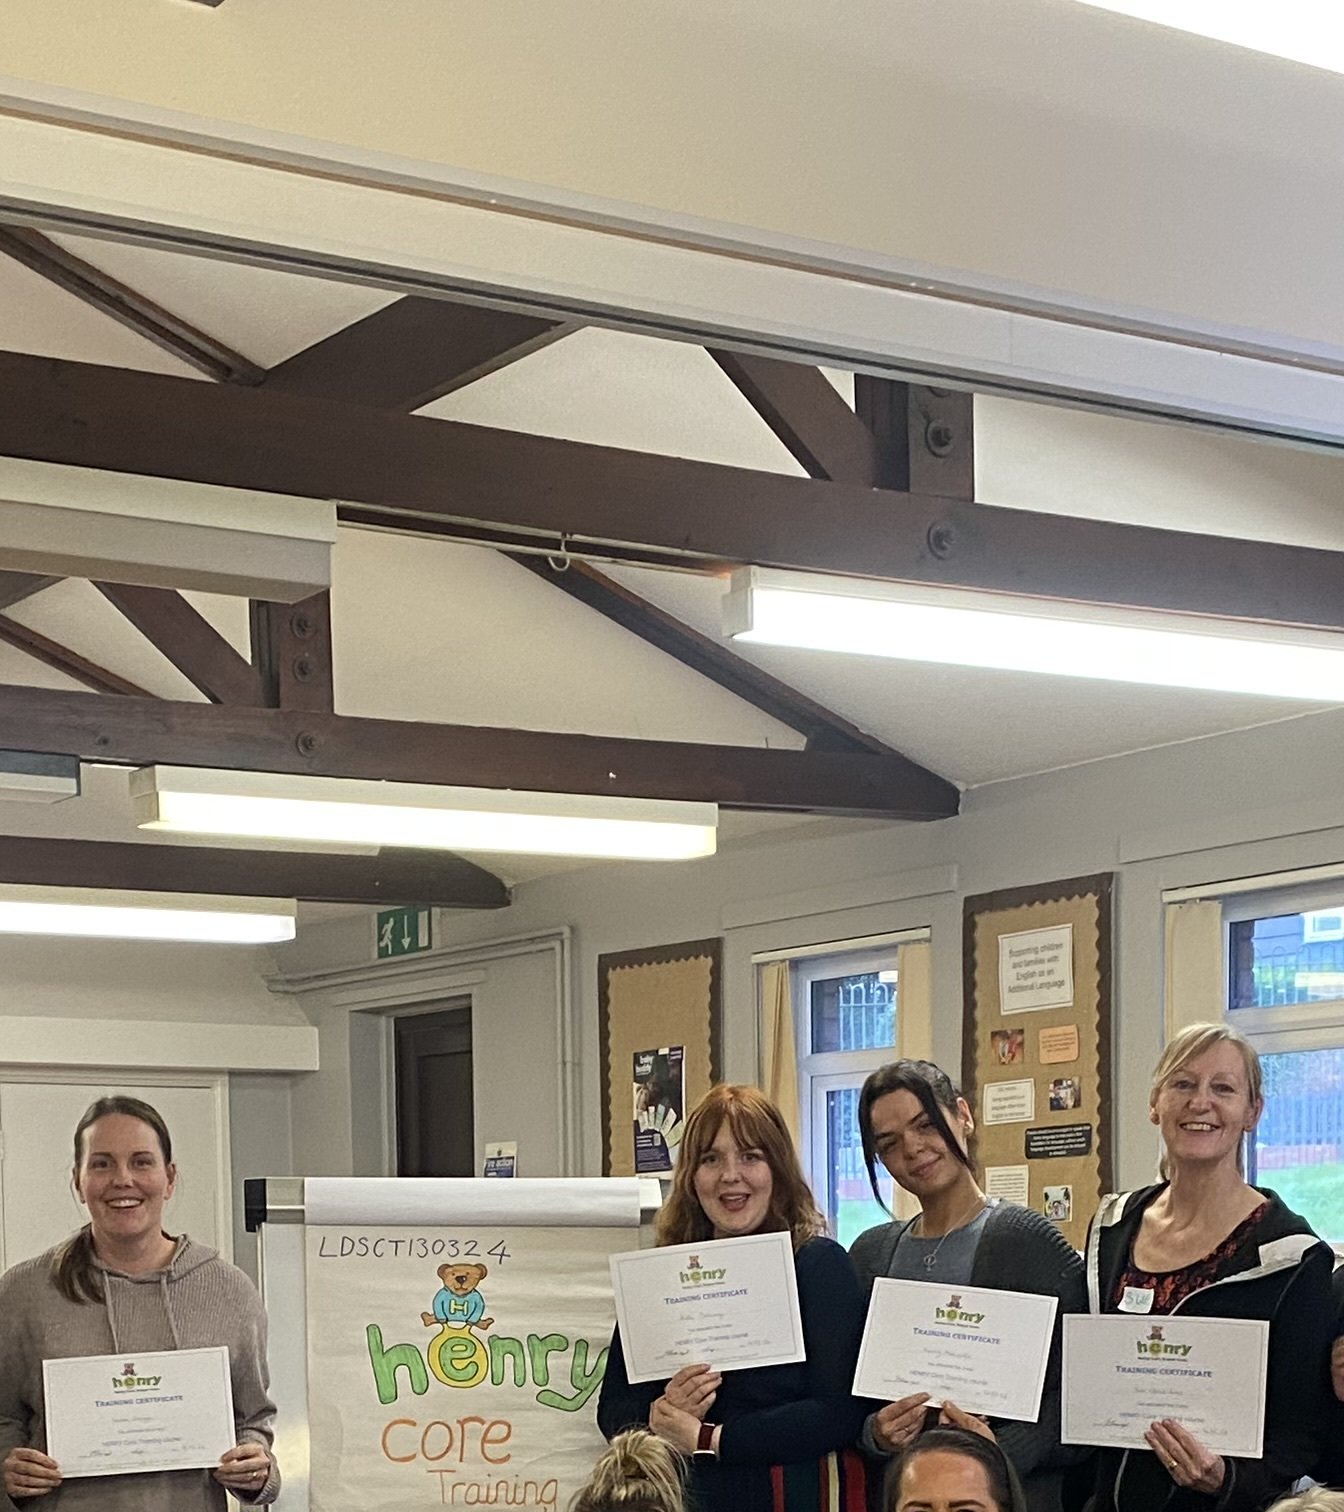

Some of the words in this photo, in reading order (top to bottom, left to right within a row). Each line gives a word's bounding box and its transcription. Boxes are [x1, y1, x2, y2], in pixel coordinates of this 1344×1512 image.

[319, 1236, 511, 1264] LDSCT130324
[679, 1268, 726, 1283] henry
[450, 1300, 468, 1314] H
[936, 1307, 985, 1324] henry
[1137, 1340, 1192, 1357] henry
[366, 1323, 612, 1412] henry
[112, 1376, 162, 1388] henry
[380, 1415, 513, 1464] core
